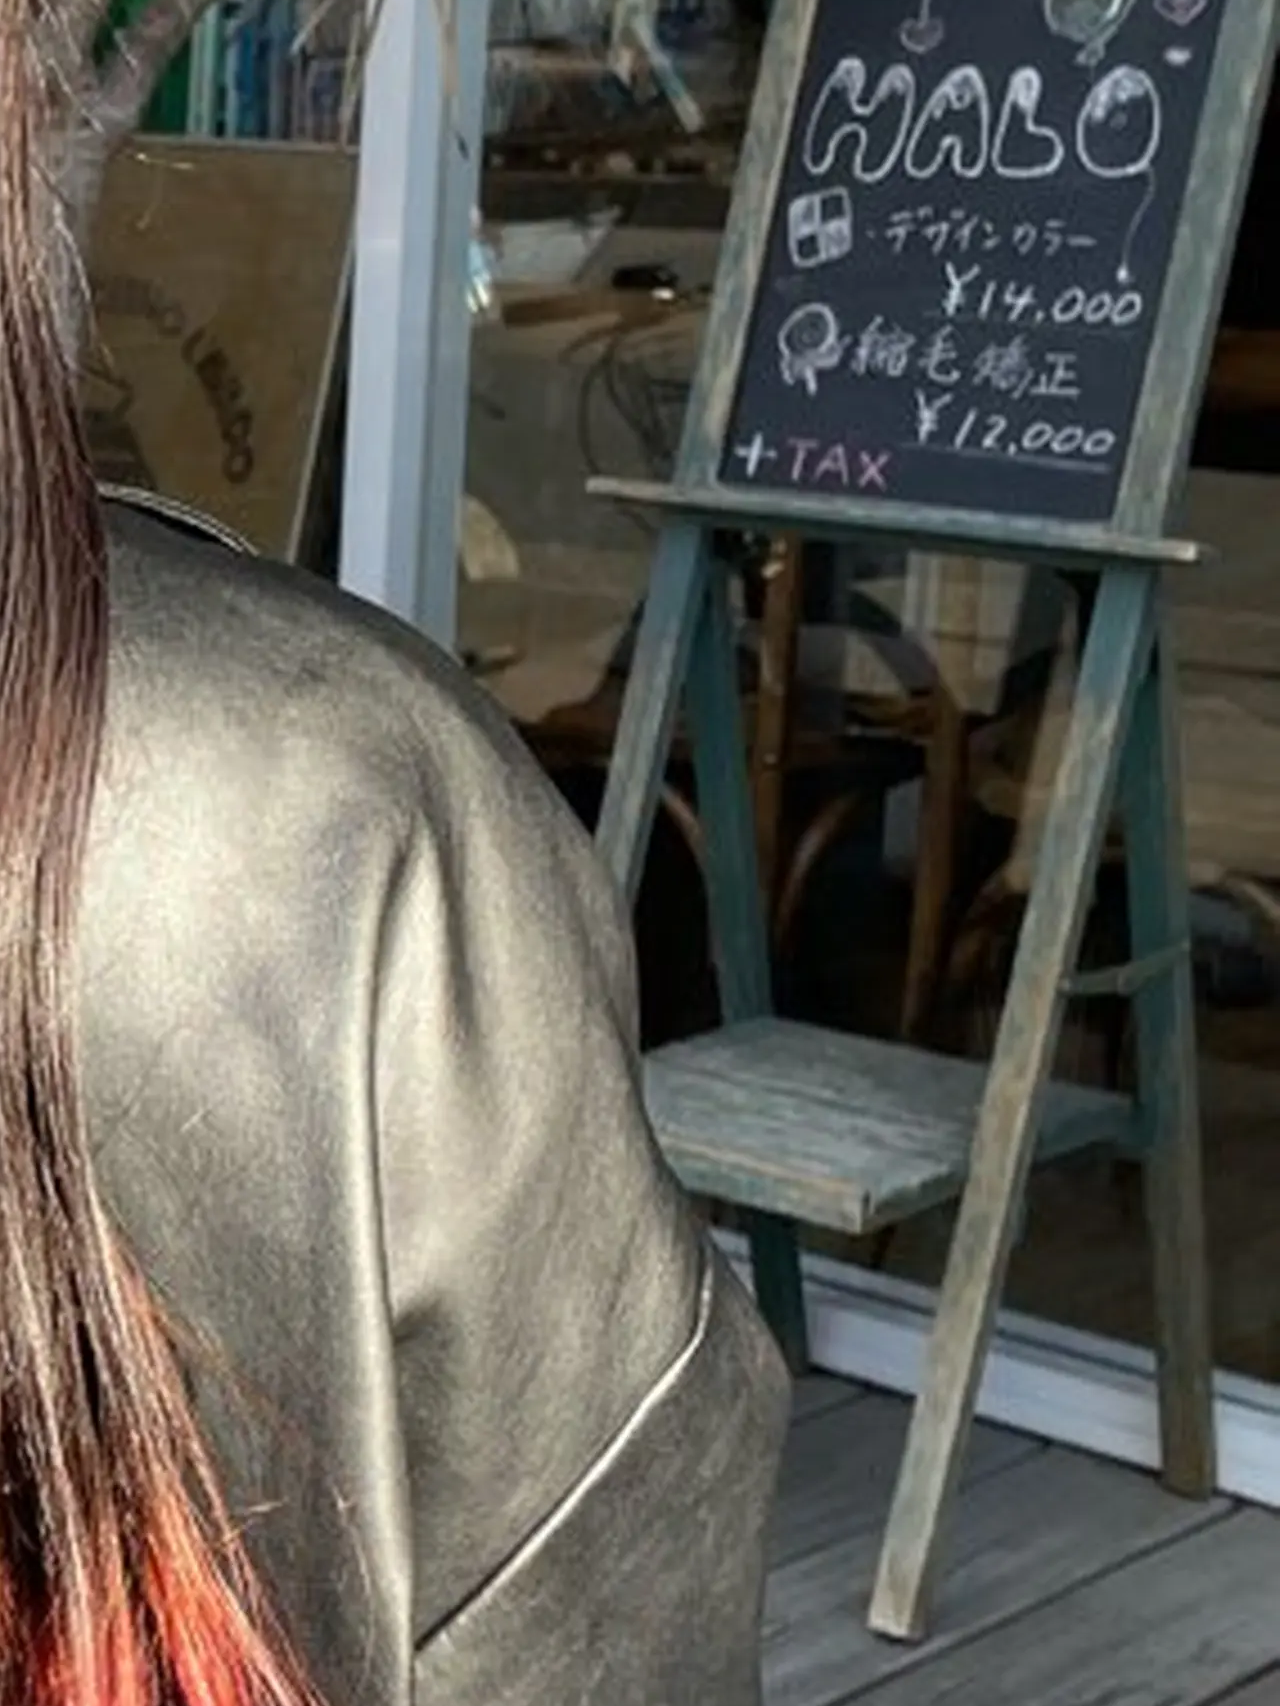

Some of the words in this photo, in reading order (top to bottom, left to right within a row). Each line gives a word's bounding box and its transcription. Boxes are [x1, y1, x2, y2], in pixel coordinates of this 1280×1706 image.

[803, 56, 1161, 184] HALO
[850, 315, 1083, 400] 縮毛矯正
